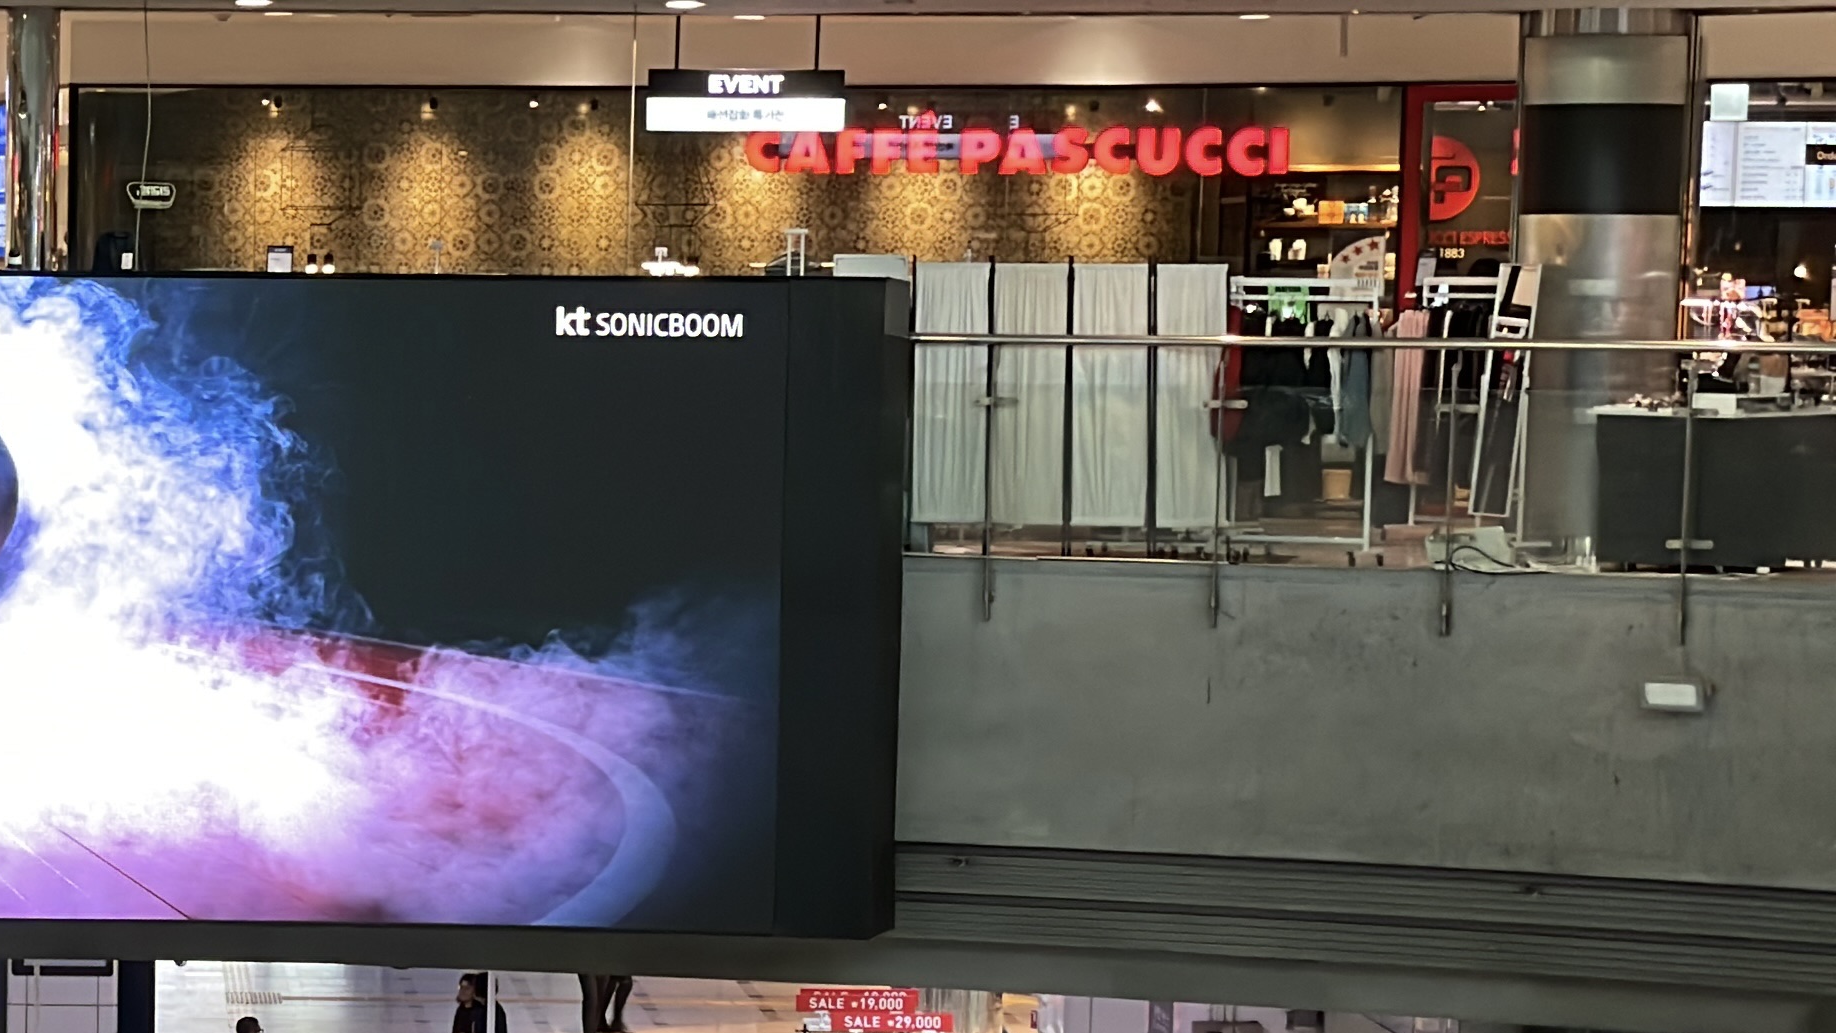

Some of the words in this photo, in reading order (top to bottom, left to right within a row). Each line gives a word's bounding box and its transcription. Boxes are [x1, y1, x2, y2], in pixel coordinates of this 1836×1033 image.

[707, 74, 785, 94] EVENT
[958, 125, 1290, 177] PASCUCCI
[1439, 247, 1465, 259] 1883
[555, 306, 591, 336] kt
[595, 312, 744, 338] SONICBOOM
[809, 997, 845, 1010] SALE
[844, 1015, 881, 1028] SALE
